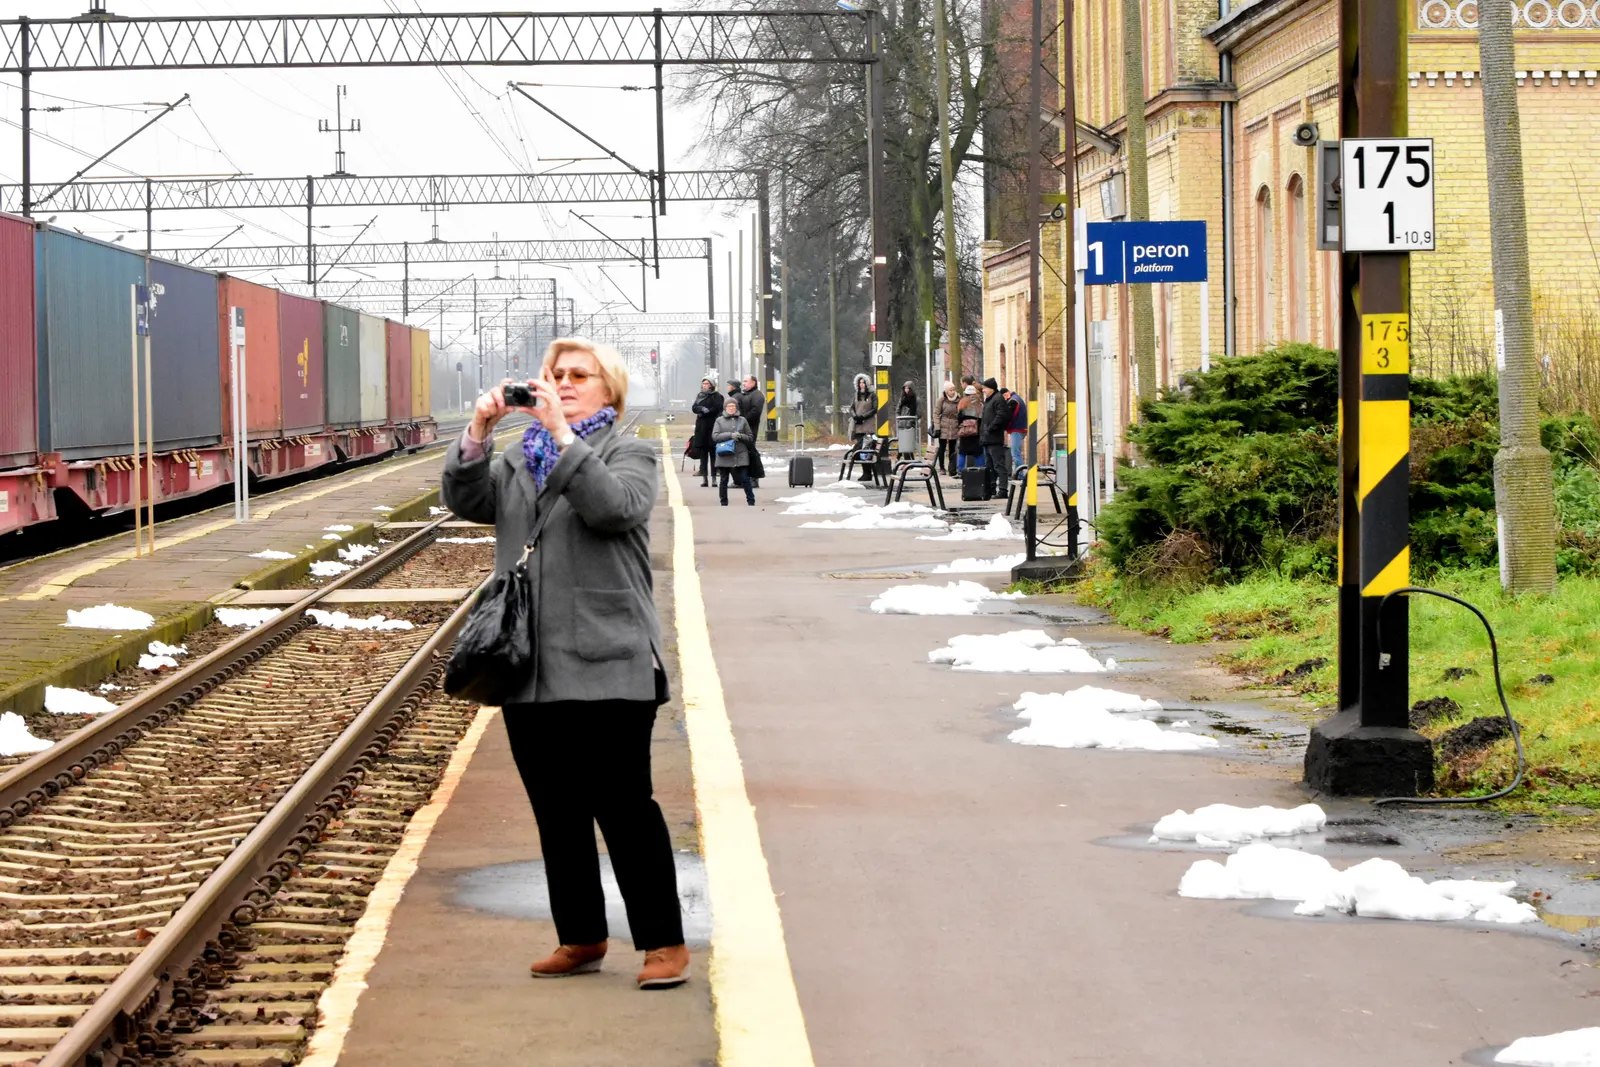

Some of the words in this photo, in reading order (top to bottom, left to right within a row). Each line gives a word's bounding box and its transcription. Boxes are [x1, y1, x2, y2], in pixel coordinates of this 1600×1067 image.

[1353, 146, 1430, 189] 175
[1383, 201, 1395, 244] 1
[1088, 241, 1104, 275] 1
[1133, 244, 1189, 262] peron
[1133, 263, 1174, 275] platform
[1366, 320, 1409, 342] 175
[874, 343, 892, 352] 175
[1377, 347, 1390, 368] 3
[877, 355, 884, 364] 0
